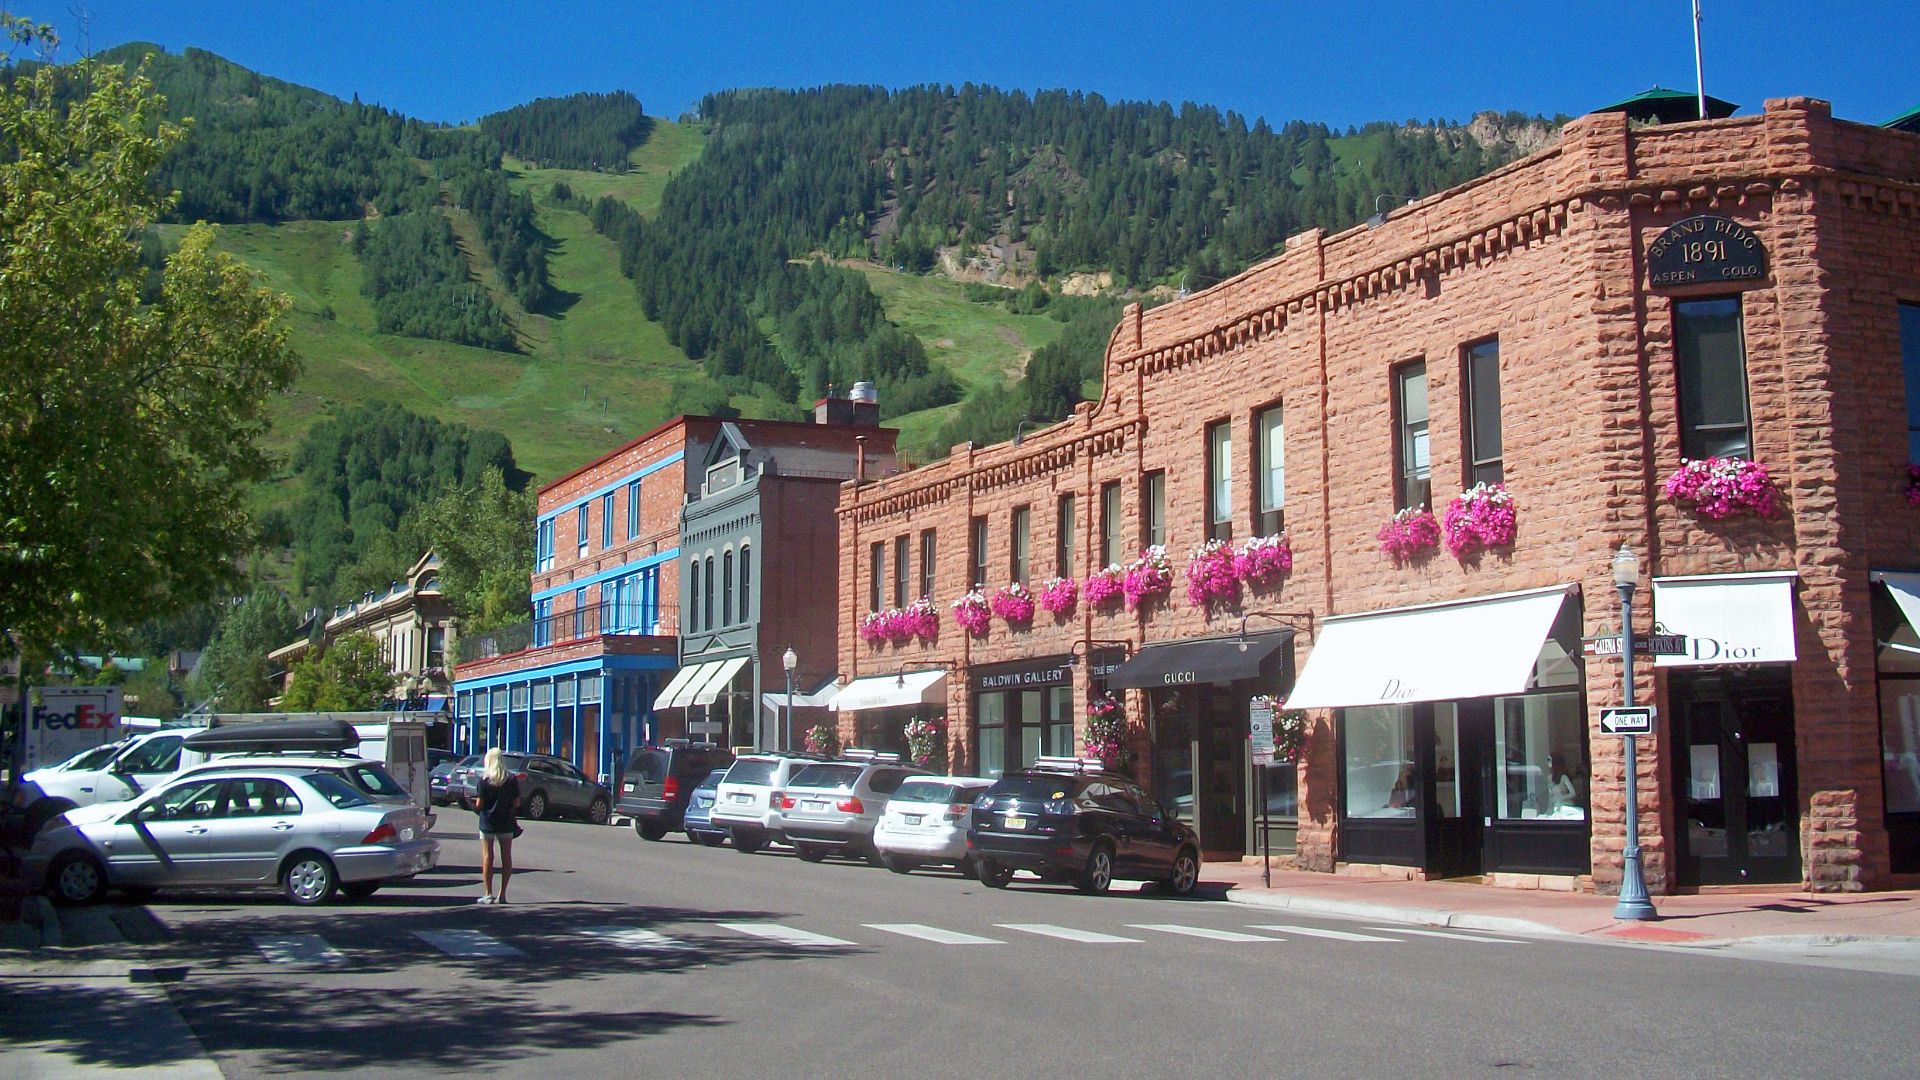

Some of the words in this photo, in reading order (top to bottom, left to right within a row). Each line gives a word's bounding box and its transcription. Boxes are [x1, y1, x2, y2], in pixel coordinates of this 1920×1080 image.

[1650, 220, 1704, 257] BRAND
[1683, 240, 1727, 263] 1891
[1653, 271, 1695, 282] ASPEN
[1594, 638, 1617, 655] GALENA
[1692, 638, 1760, 660] Dior
[982, 673, 1020, 687] BALDWIN
[1024, 669, 1064, 683] GALLERY
[1164, 671, 1195, 684] GUCCI
[1380, 678, 1418, 700] Dior
[32, 704, 115, 730] FedEx
[1615, 716, 1628, 726] ONE
[1630, 715, 1645, 725] WAY
